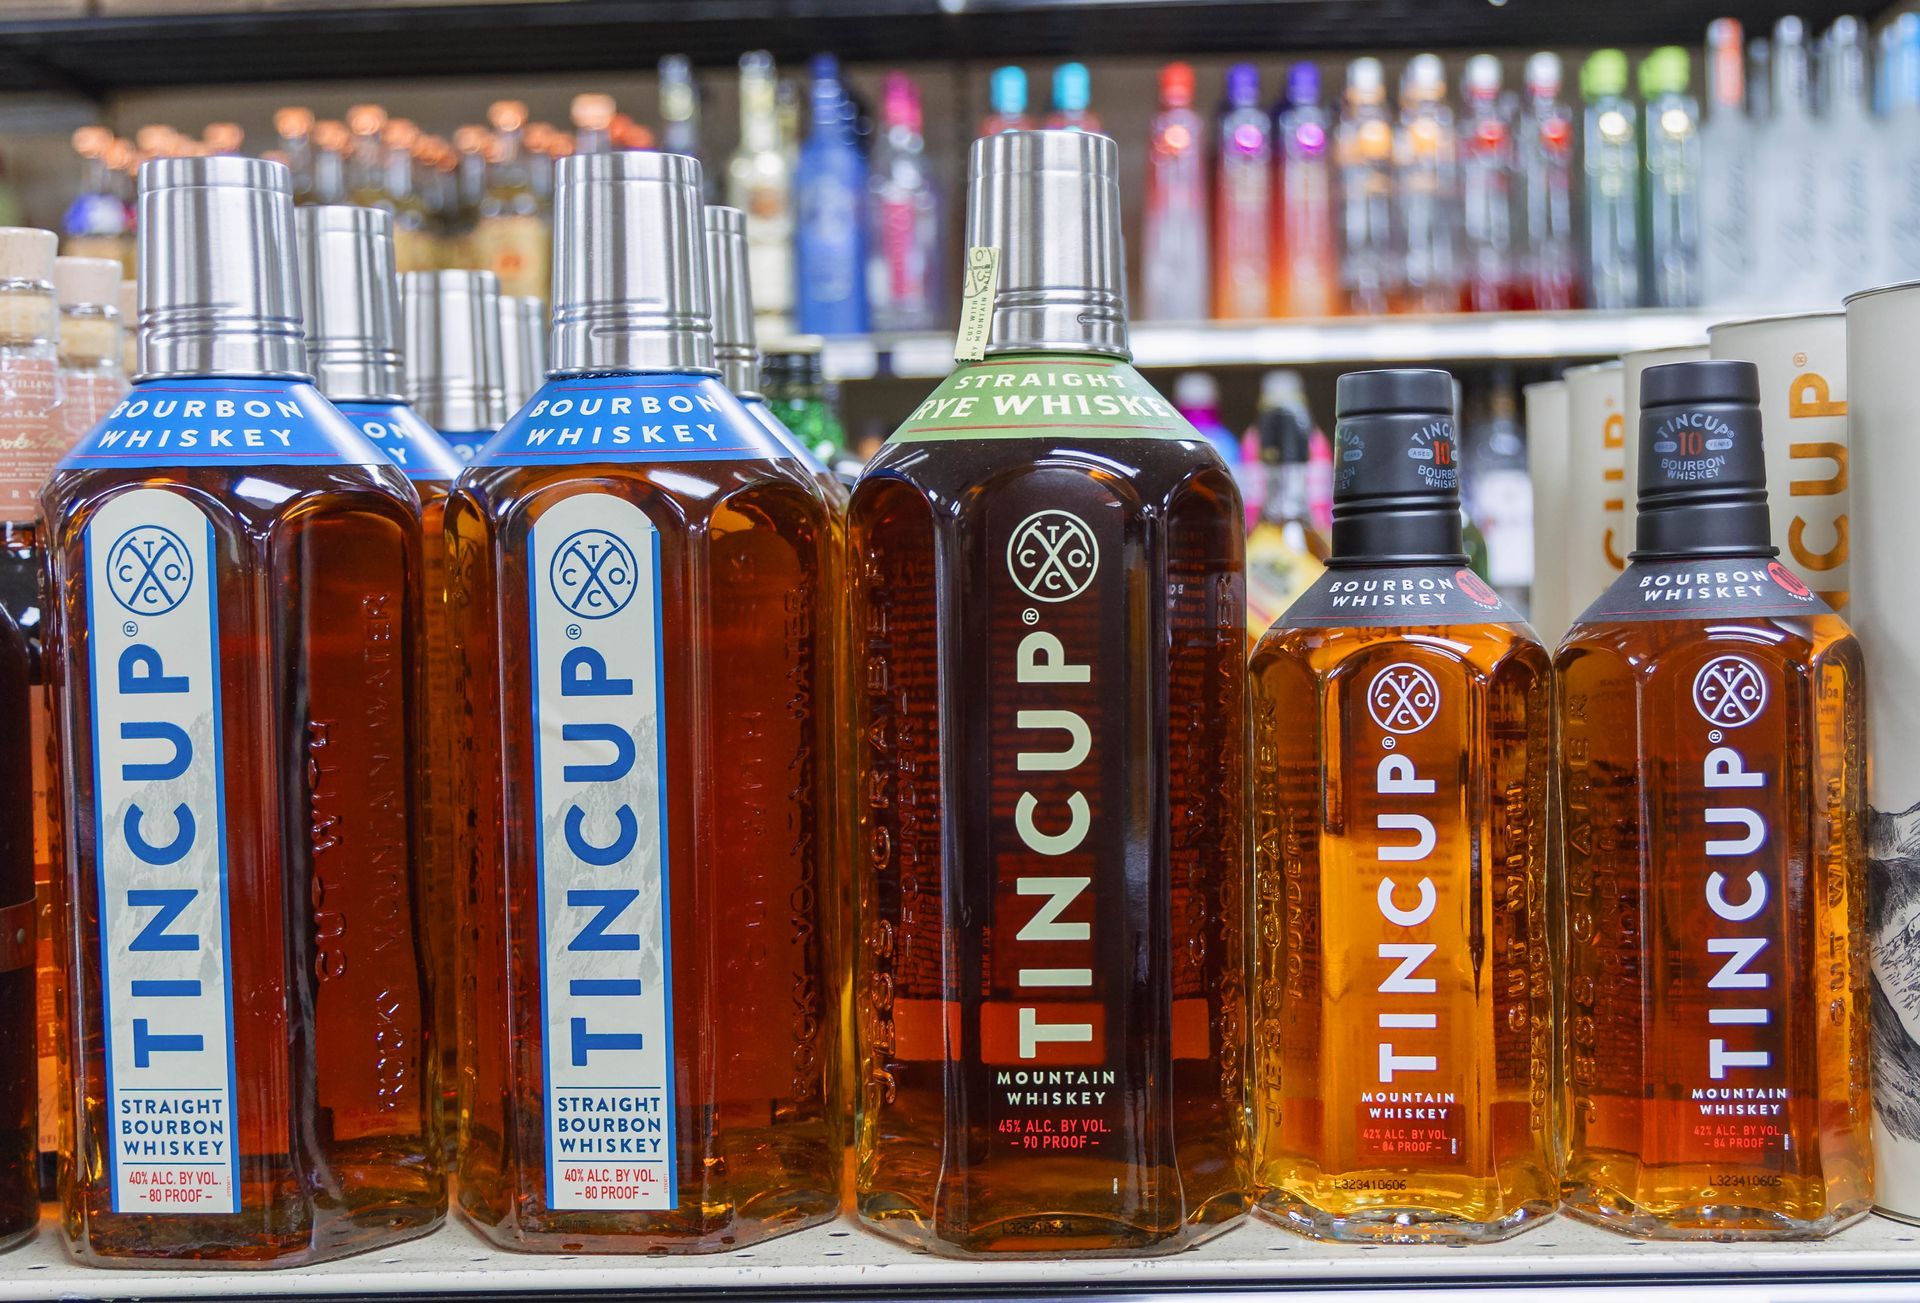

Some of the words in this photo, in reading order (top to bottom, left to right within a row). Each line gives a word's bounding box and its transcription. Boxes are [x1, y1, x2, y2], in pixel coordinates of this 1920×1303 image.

[970, 300, 978, 321] WITH
[954, 373, 1124, 390] STRAIGHT
[109, 399, 304, 419] BOURBON
[528, 395, 722, 418] BOURBON
[909, 396, 979, 422] RYE
[98, 429, 291, 448] WHISKEY
[526, 424, 718, 447] WHISKEY
[1411, 422, 1457, 446] TINCU
[1678, 431, 1703, 456] 10
[1433, 439, 1450, 465] 10
[1661, 455, 1726, 471] BOURBON
[1418, 464, 1457, 480] BOURBO
[1667, 467, 1720, 480] WHISKEY
[1329, 578, 1454, 593] BOURBON
[1639, 570, 1769, 588] BOURBON
[1332, 593, 1447, 607] WHISKEY
[1645, 585, 1763, 601] WHISKEY
[791, 971, 818, 1102] ROCKY
[997, 1071, 1115, 1085] MOUNTAIN
[1007, 1092, 1106, 1105] WHISKEY
[1361, 1092, 1455, 1103] MOUNTAIN
[1692, 1088, 1787, 1099] MOUNTAIN
[121, 1099, 222, 1114] STRAIGHT
[558, 1097, 660, 1112] STRAIGHT
[1700, 1104, 1780, 1115] WHISKEY
[1369, 1108, 1448, 1119] WHISKEY
[122, 1119, 223, 1134] BOURBON
[558, 1118, 660, 1132] BOURBON
[998, 1119, 1021, 1133] 45%
[1026, 1119, 1055, 1133] ALC.
[1061, 1119, 1078, 1133] BY
[1082, 1119, 1111, 1133] VOL.
[1694, 1125, 1712, 1136] 42%
[1743, 1125, 1757, 1136] BY
[1363, 1129, 1380, 1140] 42%
[1412, 1129, 1424, 1140] BY
[124, 1141, 223, 1155] WHISKEY
[560, 1138, 661, 1153] WHISKEY
[129, 1171, 148, 1185] 40%
[151, 1171, 176, 1185] ALC.
[180, 1171, 193, 1185] BY
[196, 1171, 221, 1185] VOL.
[564, 1169, 584, 1182] 40%
[587, 1169, 612, 1182] ALC.
[616, 1169, 630, 1182] BY
[633, 1169, 659, 1182] VOL.
